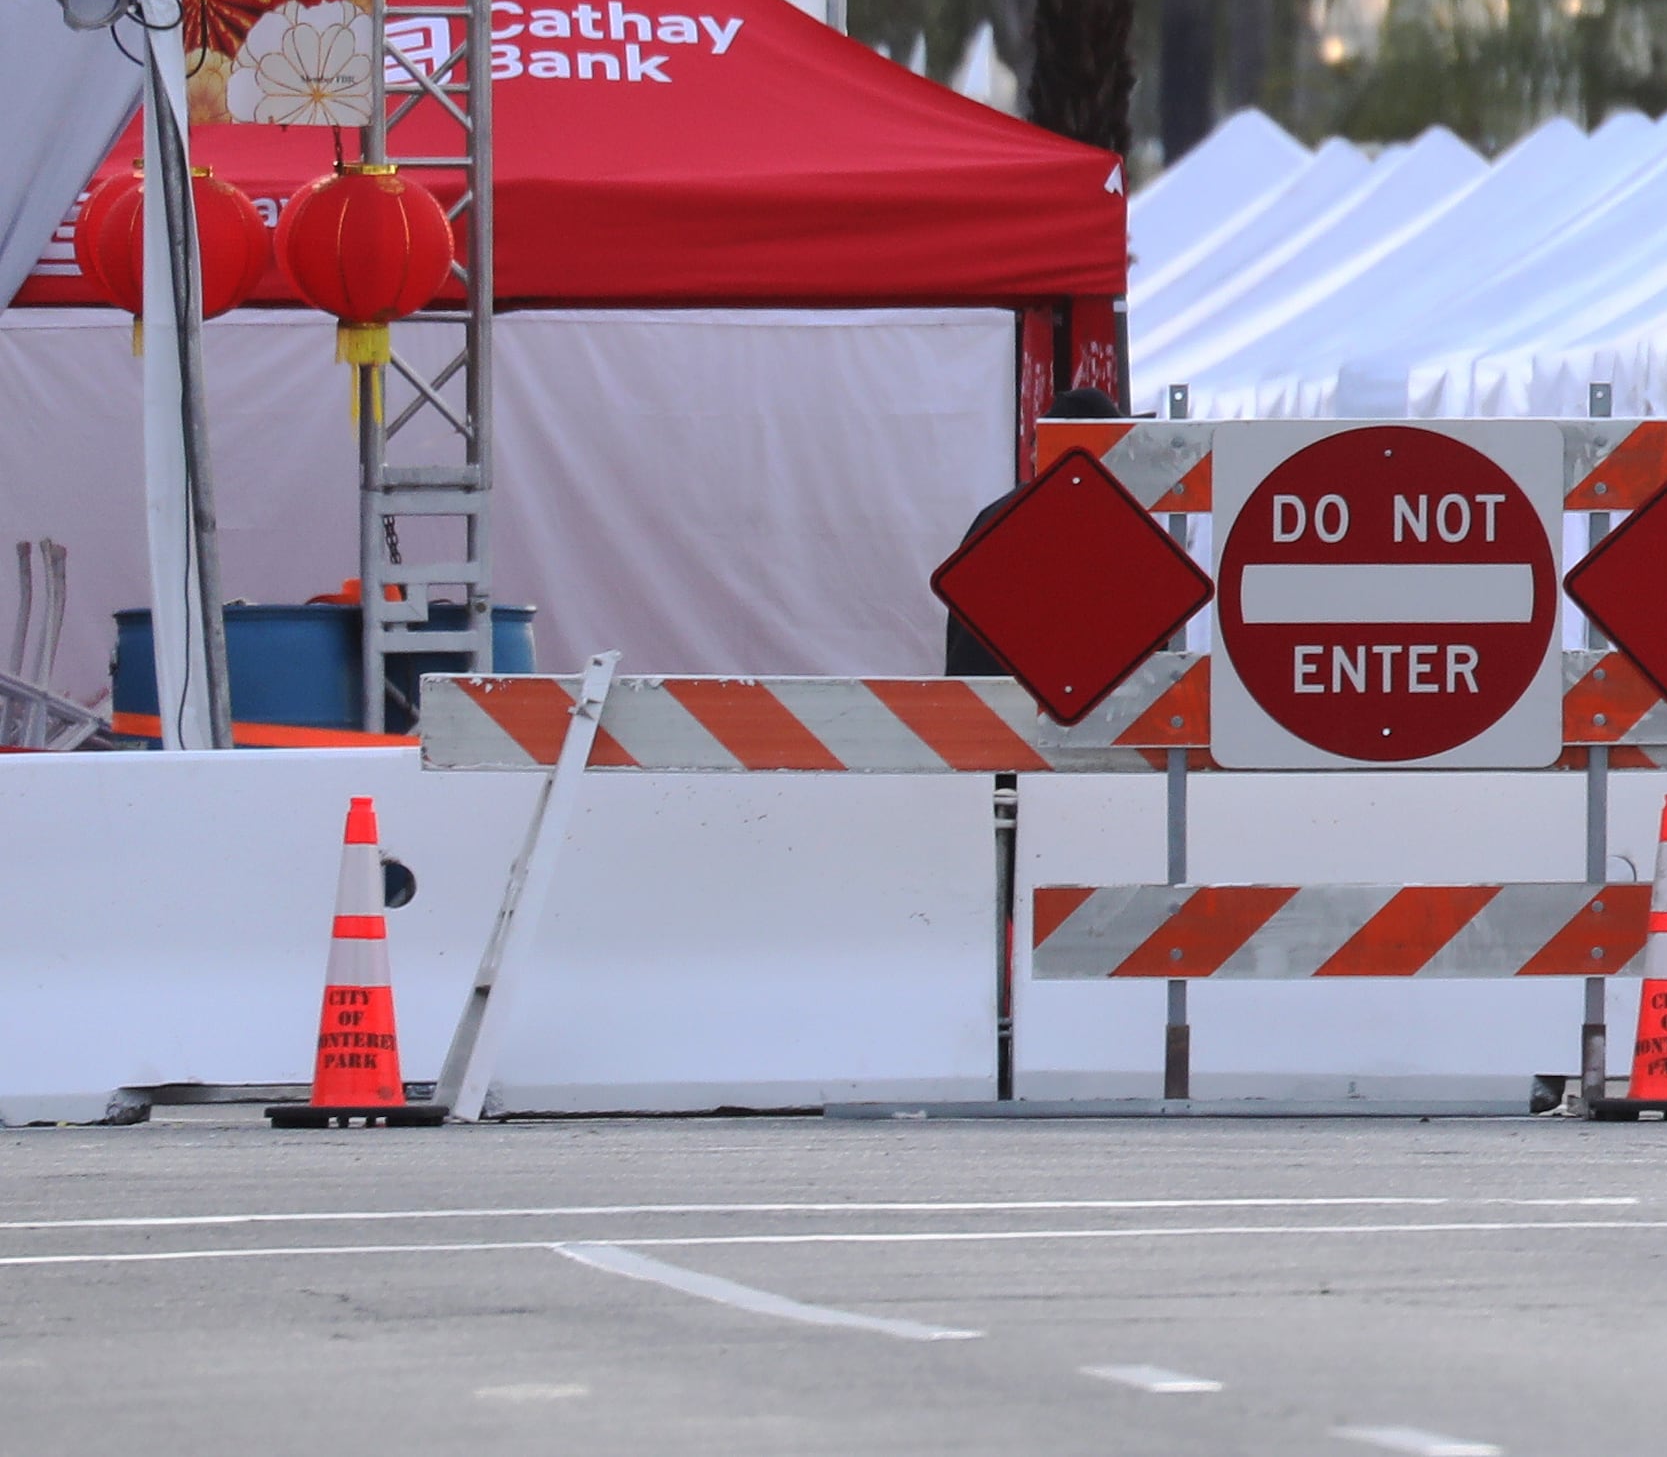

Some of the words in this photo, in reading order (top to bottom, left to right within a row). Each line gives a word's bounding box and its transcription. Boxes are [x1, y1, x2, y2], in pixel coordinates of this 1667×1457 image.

[491, 1, 744, 54] Cathay
[491, 43, 672, 83] Bank
[1272, 493, 1350, 543] DO
[1393, 493, 1506, 543] NOT
[1293, 645, 1479, 693] ENTER
[329, 990, 370, 1006] CITY
[338, 1010, 363, 1026] OF
[324, 1053, 377, 1069] PARK
